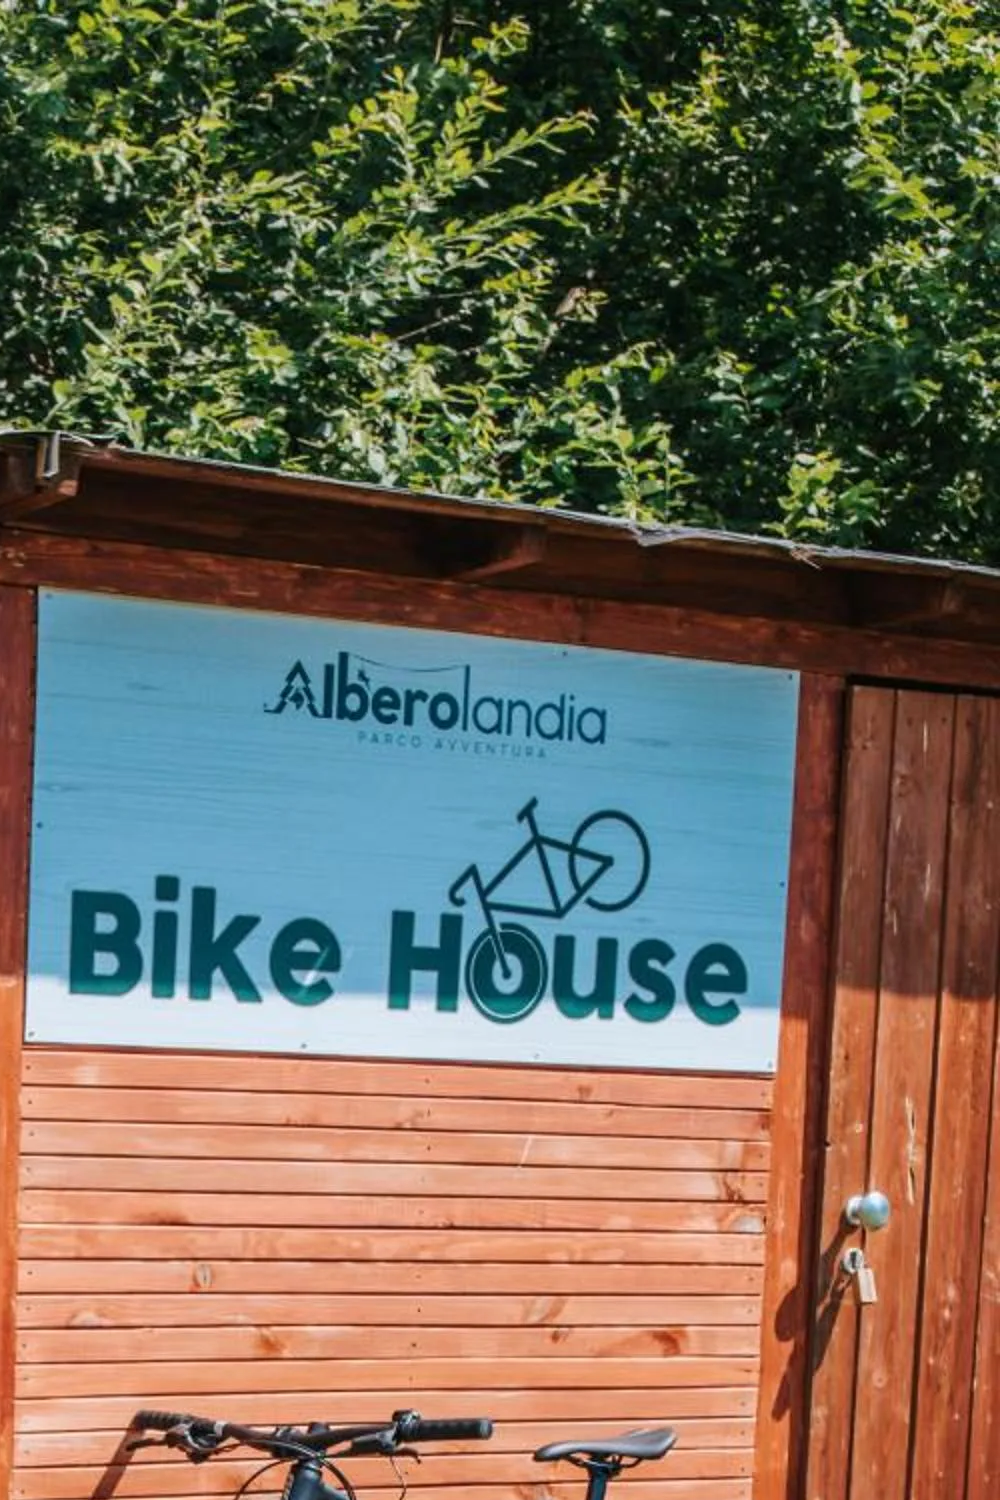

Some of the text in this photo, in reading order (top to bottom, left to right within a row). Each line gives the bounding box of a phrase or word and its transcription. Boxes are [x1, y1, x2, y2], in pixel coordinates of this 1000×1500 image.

[264, 651, 607, 745] Alberolandia
[357, 730, 547, 760] PARCO AVVENTURA
[68, 873, 749, 1027] Bike House
